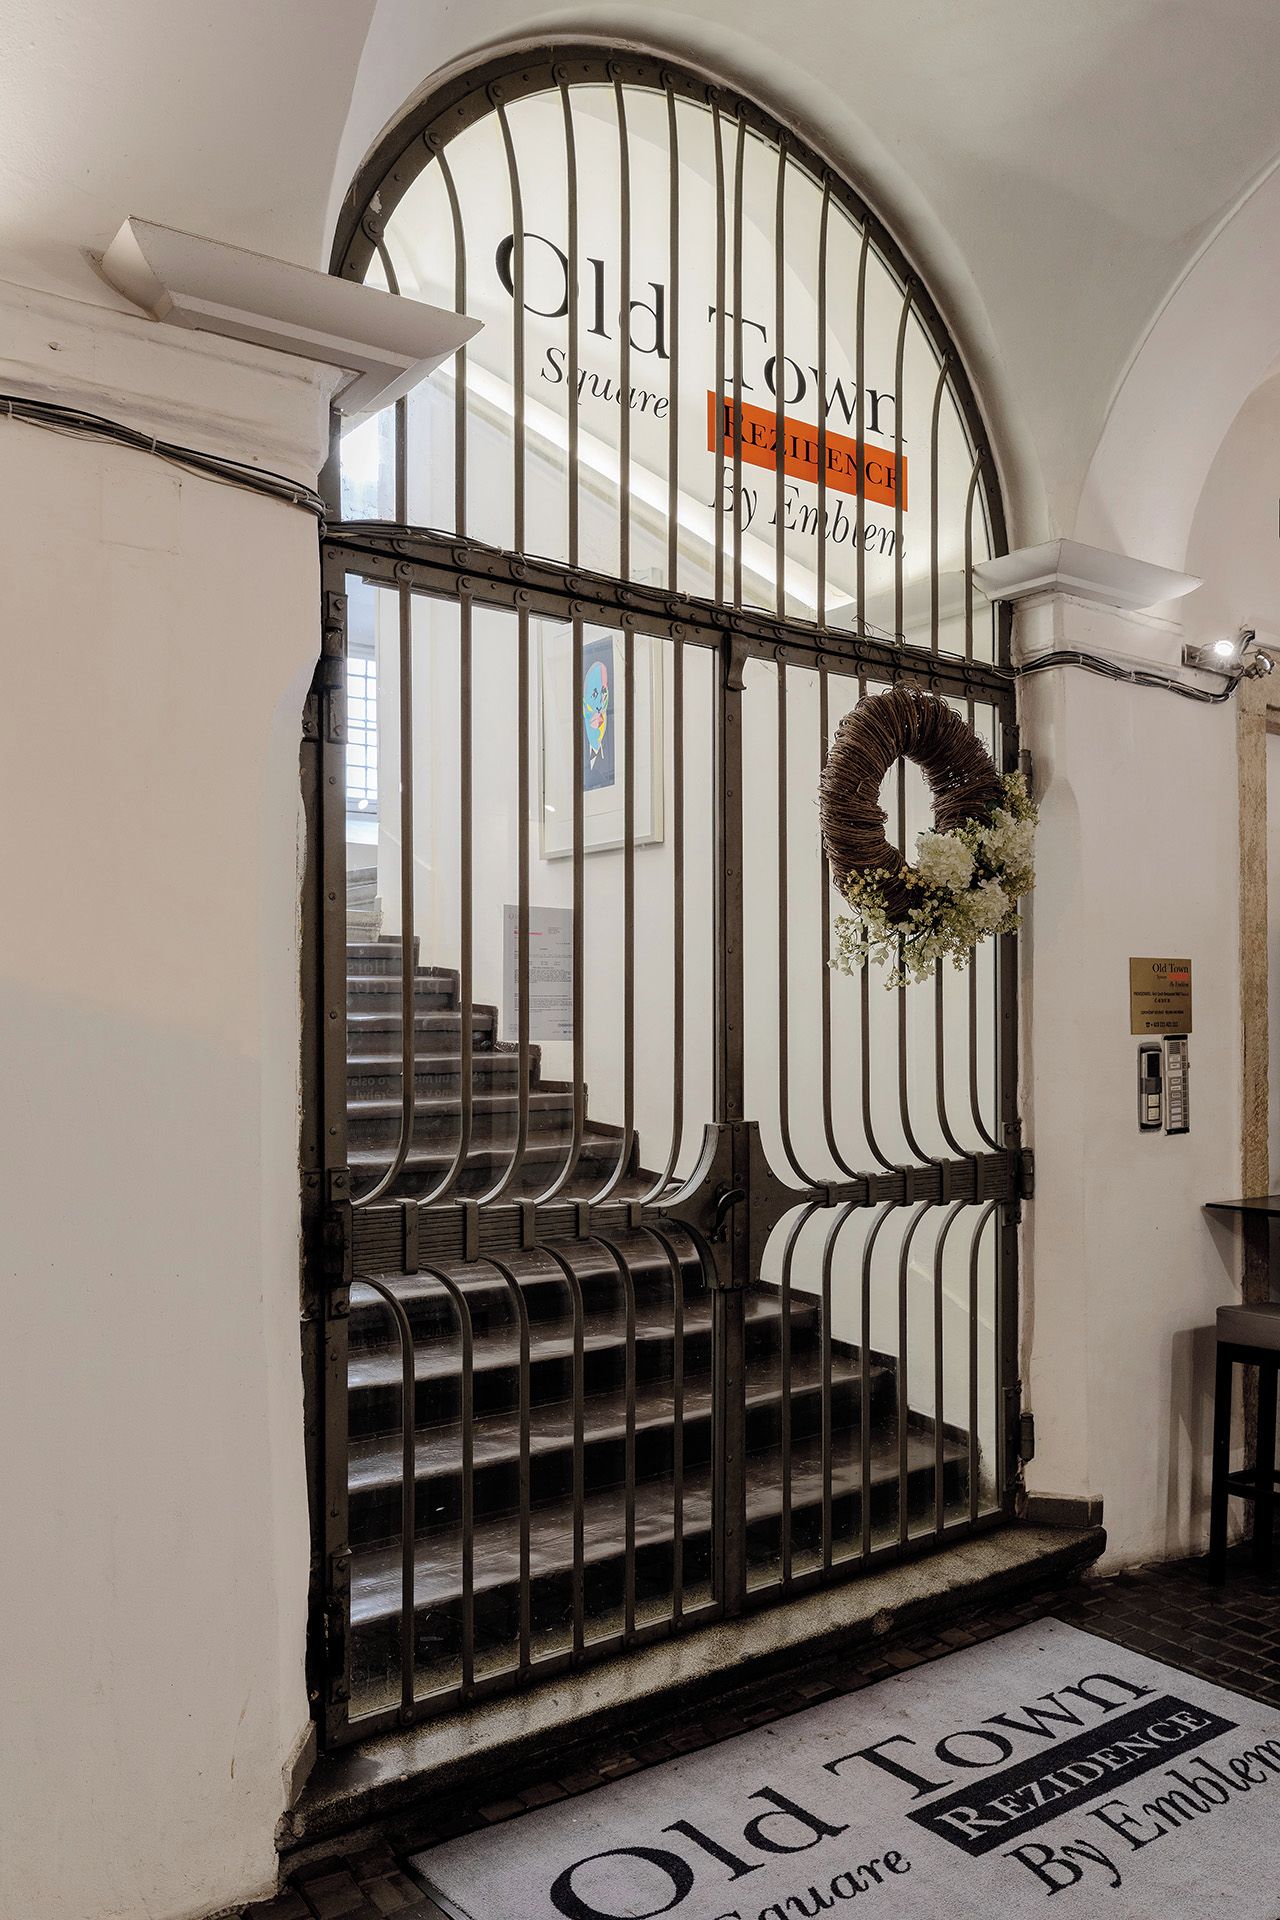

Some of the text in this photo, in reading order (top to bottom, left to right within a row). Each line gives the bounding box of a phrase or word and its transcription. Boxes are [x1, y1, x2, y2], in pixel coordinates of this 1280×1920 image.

[495, 232, 908, 443] Old Town
[541, 347, 669, 418] Square
[723, 404, 900, 491] REZIDENCE
[708, 466, 757, 532] By
[1152, 963, 1189, 973] Old Town
[550, 1673, 1157, 1920] Old Town
[934, 1711, 1212, 1841] REZIDENCE
[1002, 1738, 1280, 1897] By Emblem
[714, 1850, 911, 1920] uare
